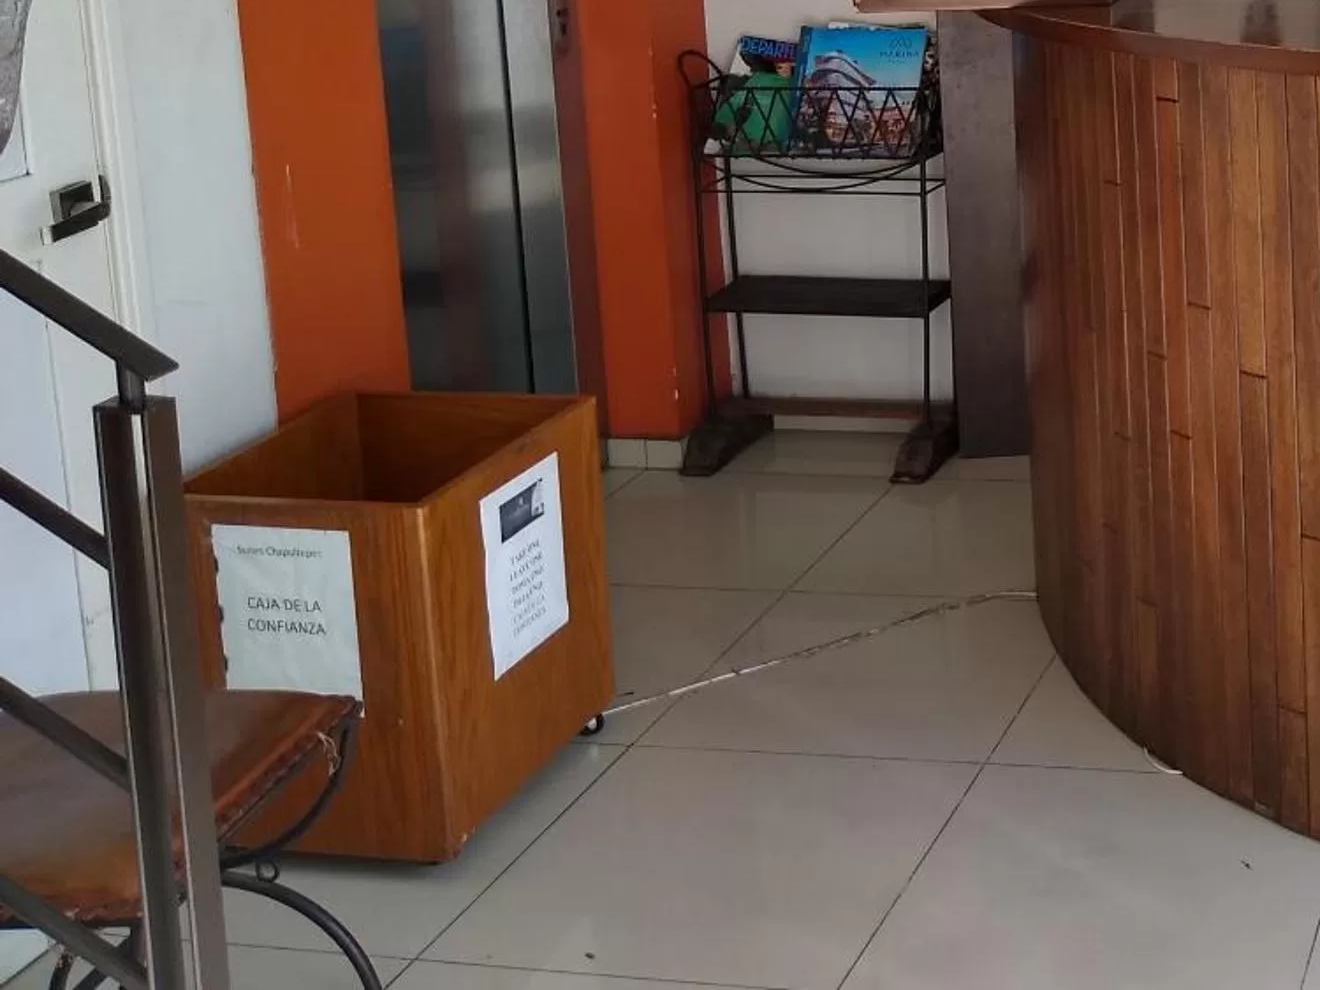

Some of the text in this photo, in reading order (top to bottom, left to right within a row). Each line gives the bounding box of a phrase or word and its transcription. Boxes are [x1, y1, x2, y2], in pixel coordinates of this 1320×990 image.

[247, 597, 321, 613] CAJA DE LA
[247, 617, 327, 636] CONFIANZA
